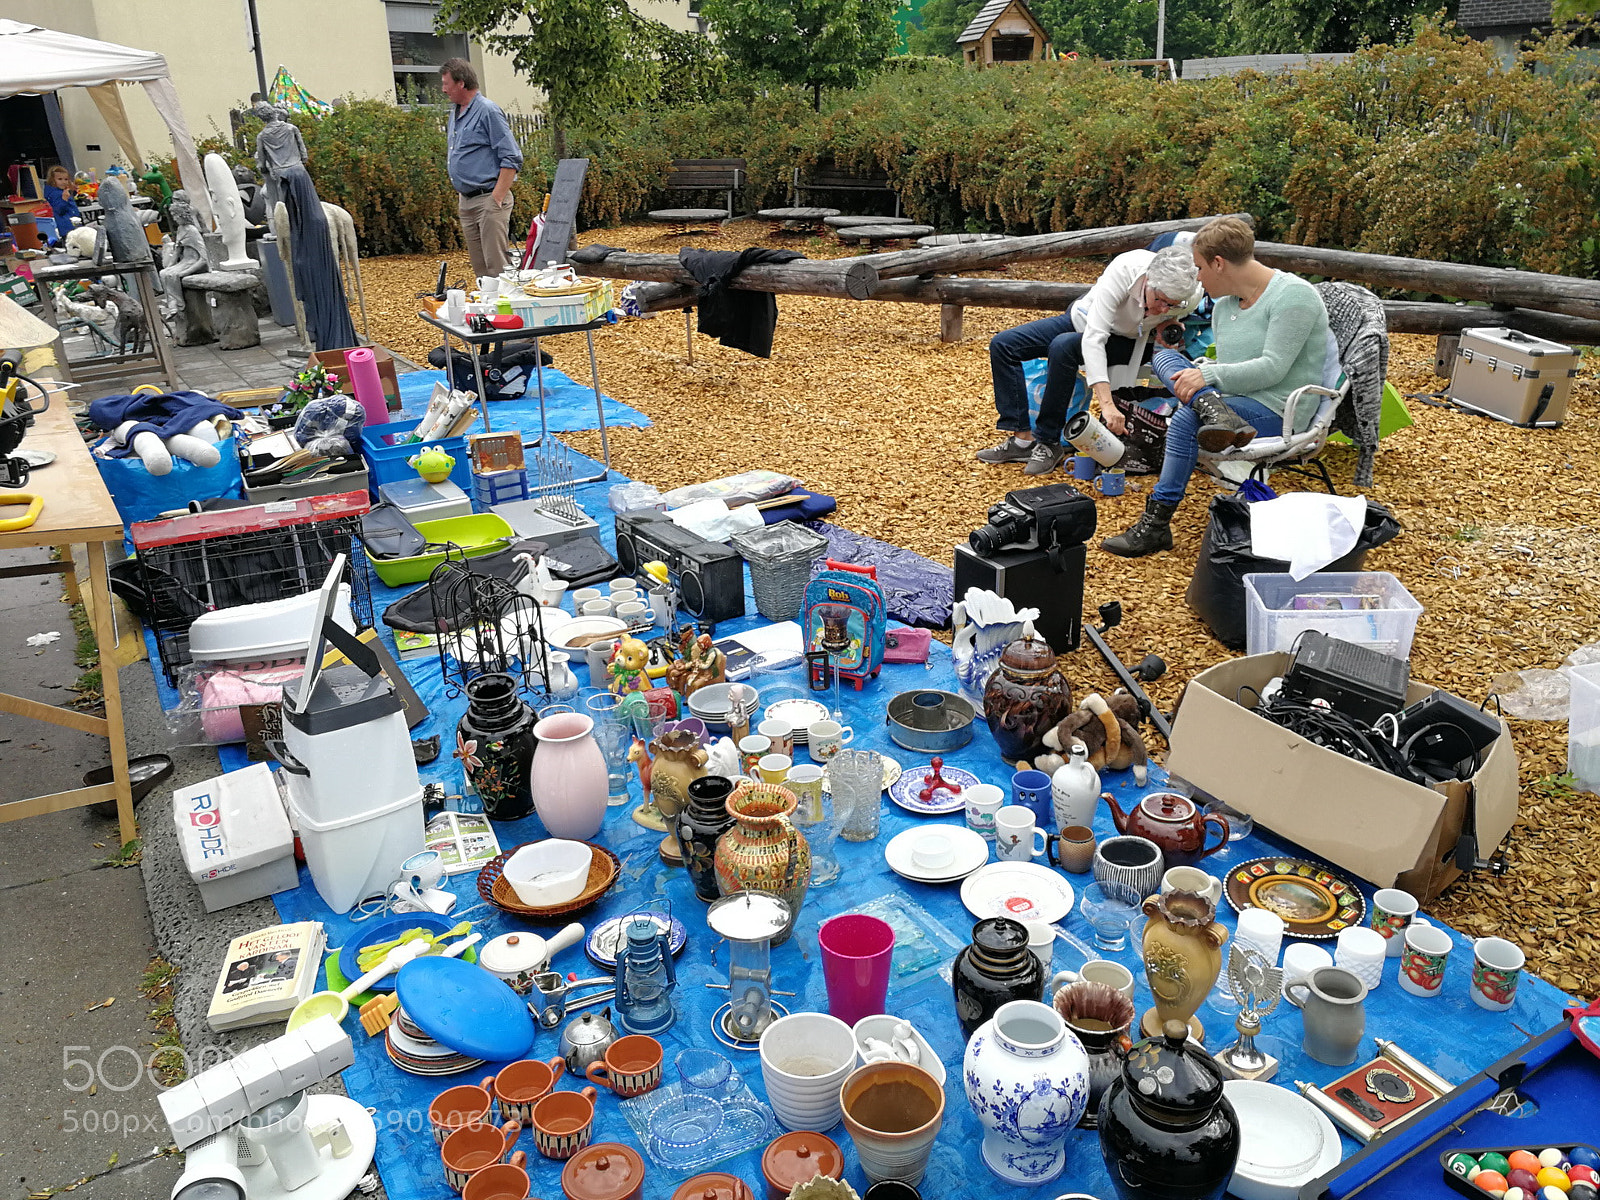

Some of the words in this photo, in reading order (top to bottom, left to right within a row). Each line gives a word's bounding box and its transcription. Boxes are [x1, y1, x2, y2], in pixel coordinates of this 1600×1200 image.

[828, 588, 849, 599] Bob
[190, 793, 225, 859] ROHDE
[201, 863, 237, 880] ROHDE
[240, 944, 292, 959] KARDINAAL
[248, 942, 266, 951] VAN
